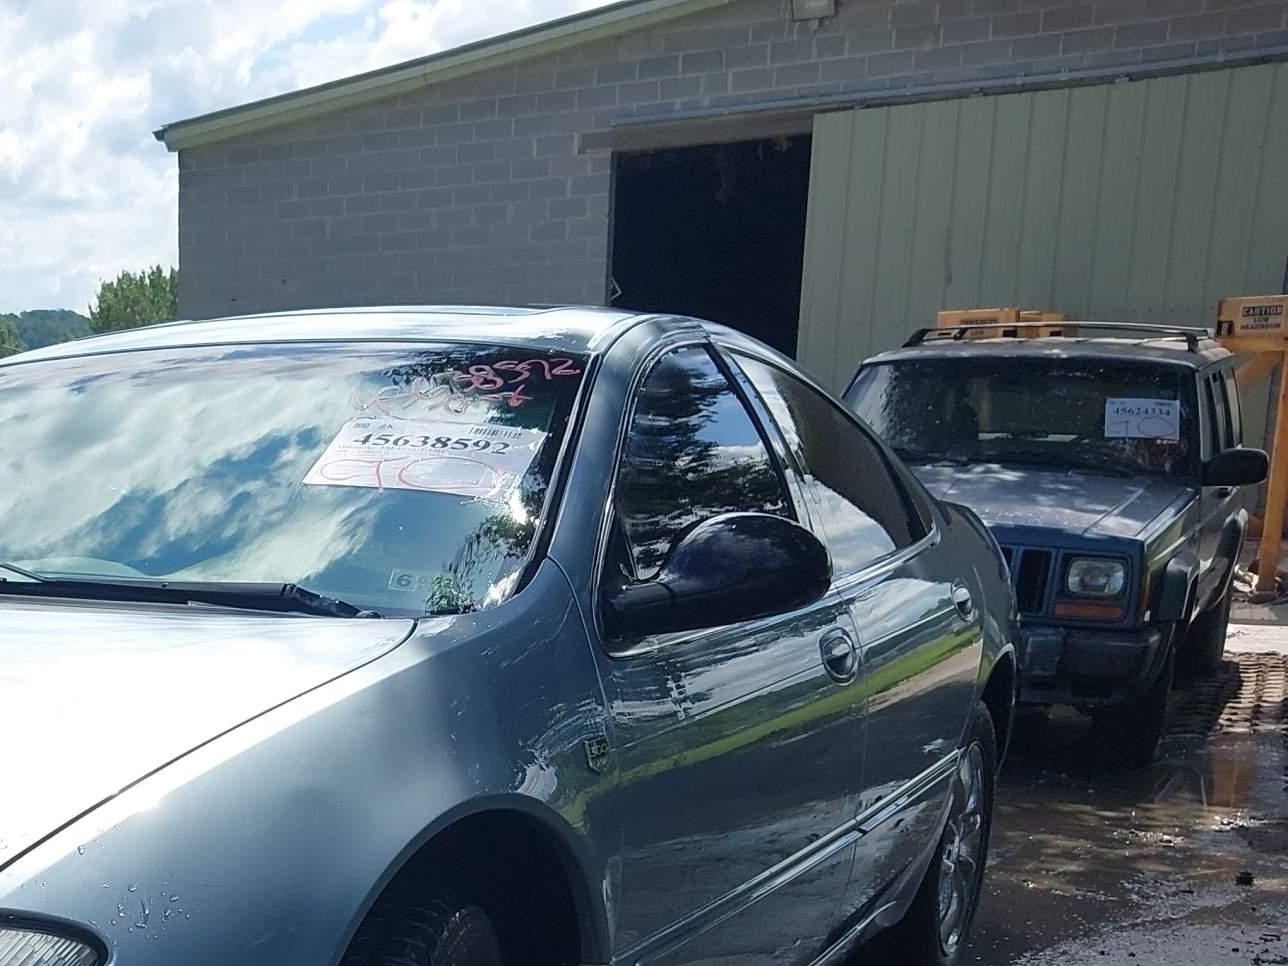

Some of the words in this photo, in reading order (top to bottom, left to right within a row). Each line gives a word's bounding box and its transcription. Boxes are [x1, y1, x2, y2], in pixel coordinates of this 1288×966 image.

[1242, 306, 1282, 316] CAUTION
[353, 433, 510, 455] 45638592
[396, 574, 412, 587] 6
